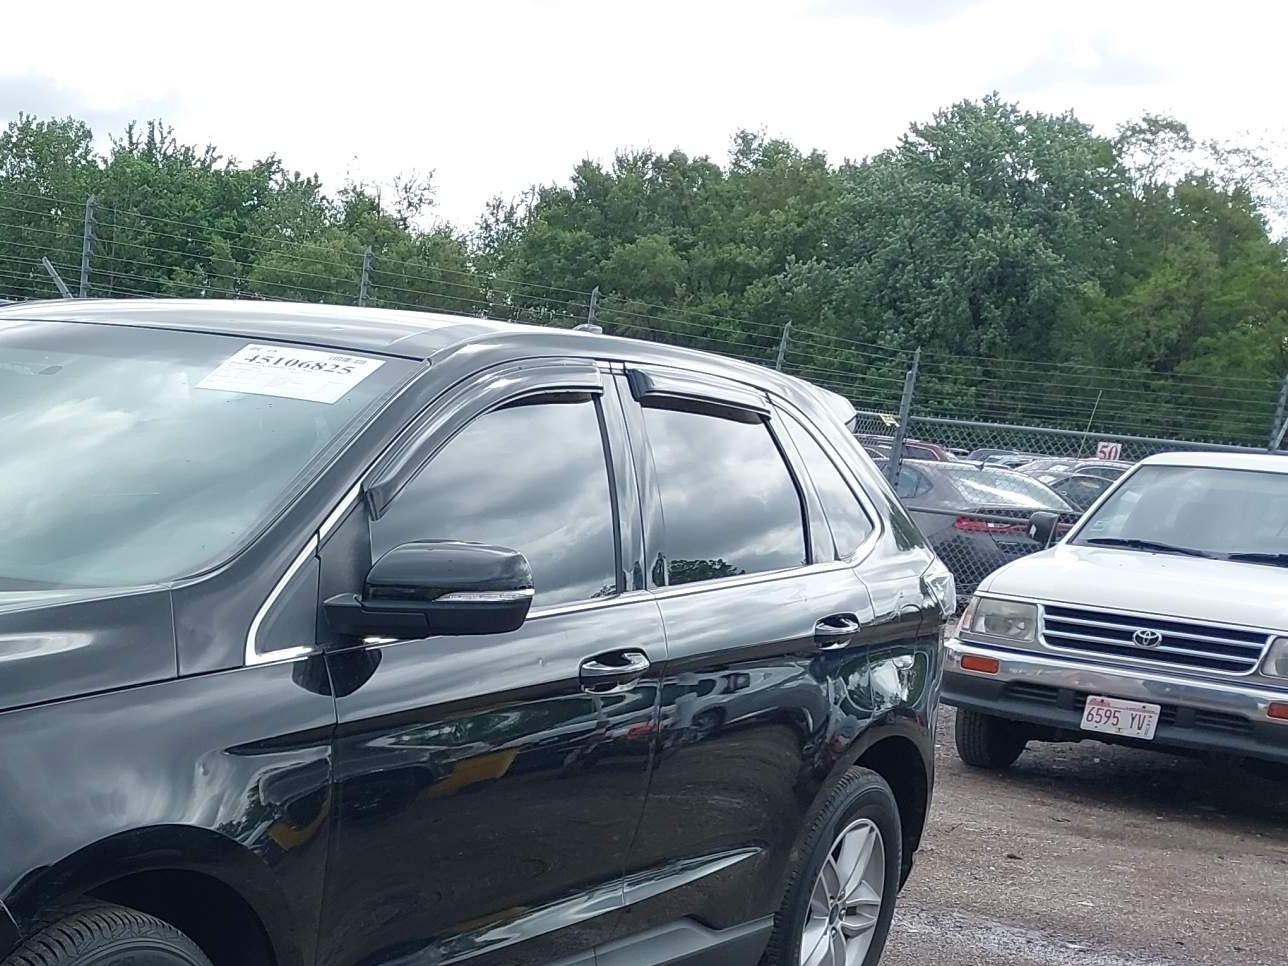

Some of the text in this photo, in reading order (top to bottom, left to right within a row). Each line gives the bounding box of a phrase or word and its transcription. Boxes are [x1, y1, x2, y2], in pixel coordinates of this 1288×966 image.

[244, 353, 357, 375] 45106825
[1099, 444, 1118, 461] 50
[1086, 706, 1121, 727] 6595
